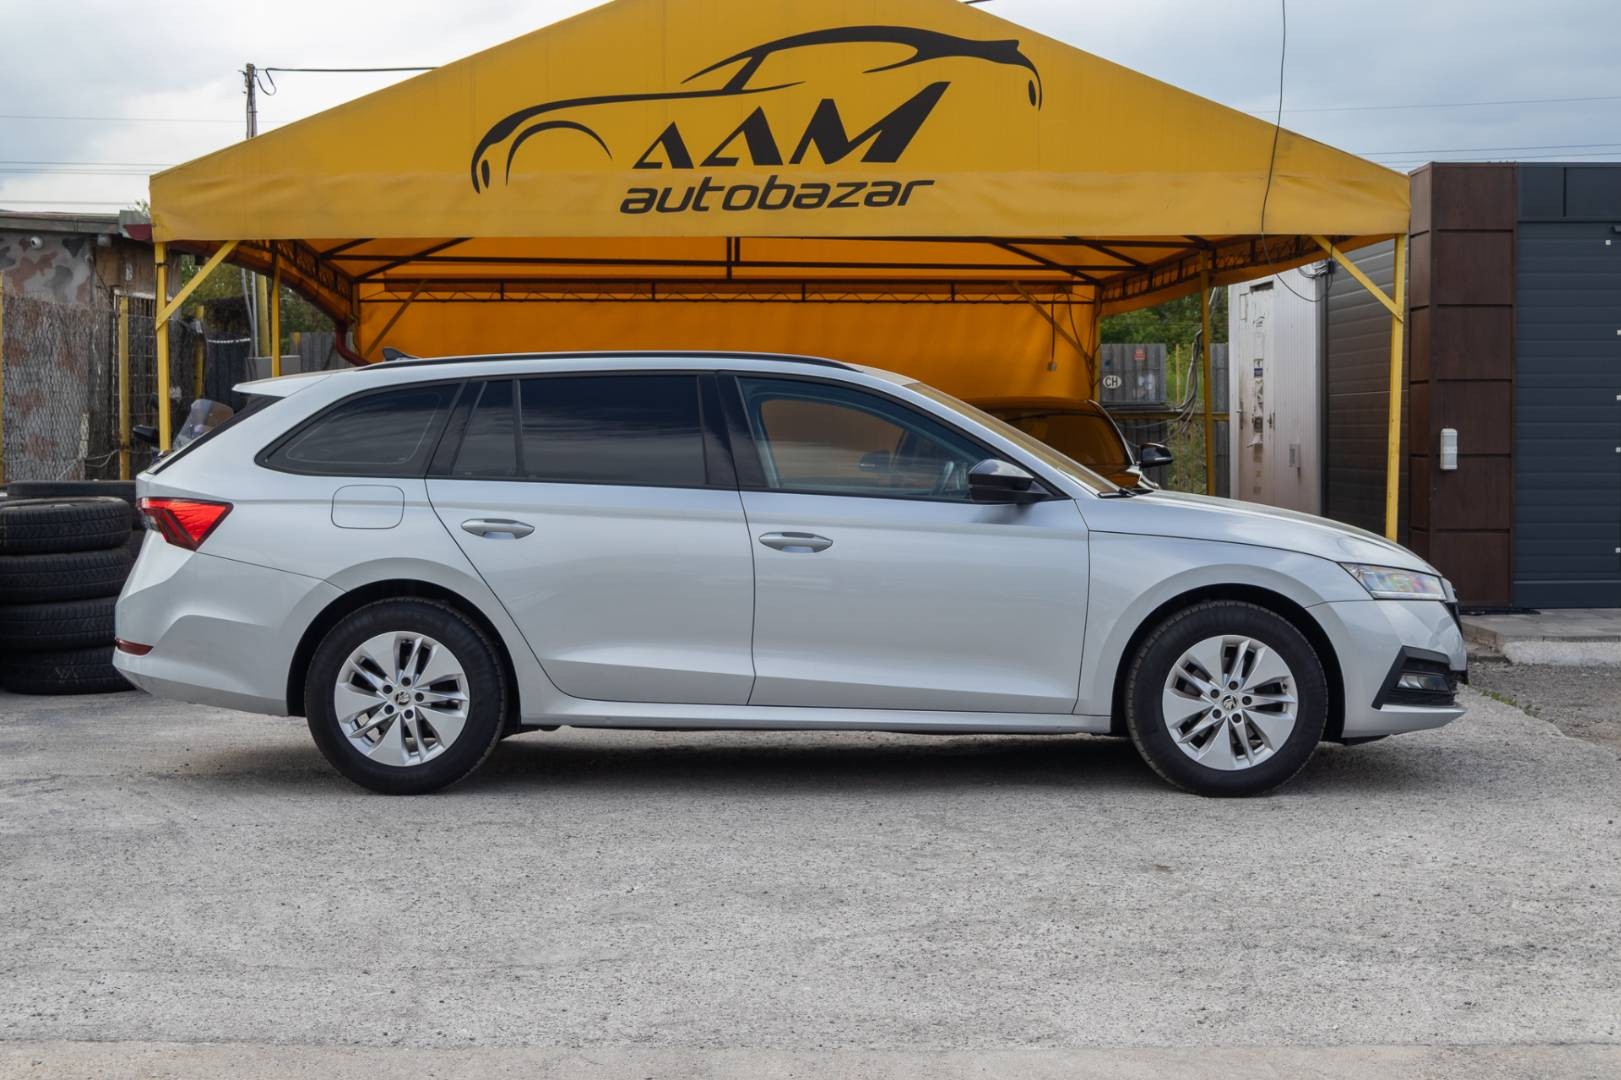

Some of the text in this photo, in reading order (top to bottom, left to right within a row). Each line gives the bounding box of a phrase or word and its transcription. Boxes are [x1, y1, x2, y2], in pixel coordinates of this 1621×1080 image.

[632, 81, 951, 169] AAM
[619, 175, 935, 214] autobazar
[1105, 376, 1118, 387] CH
